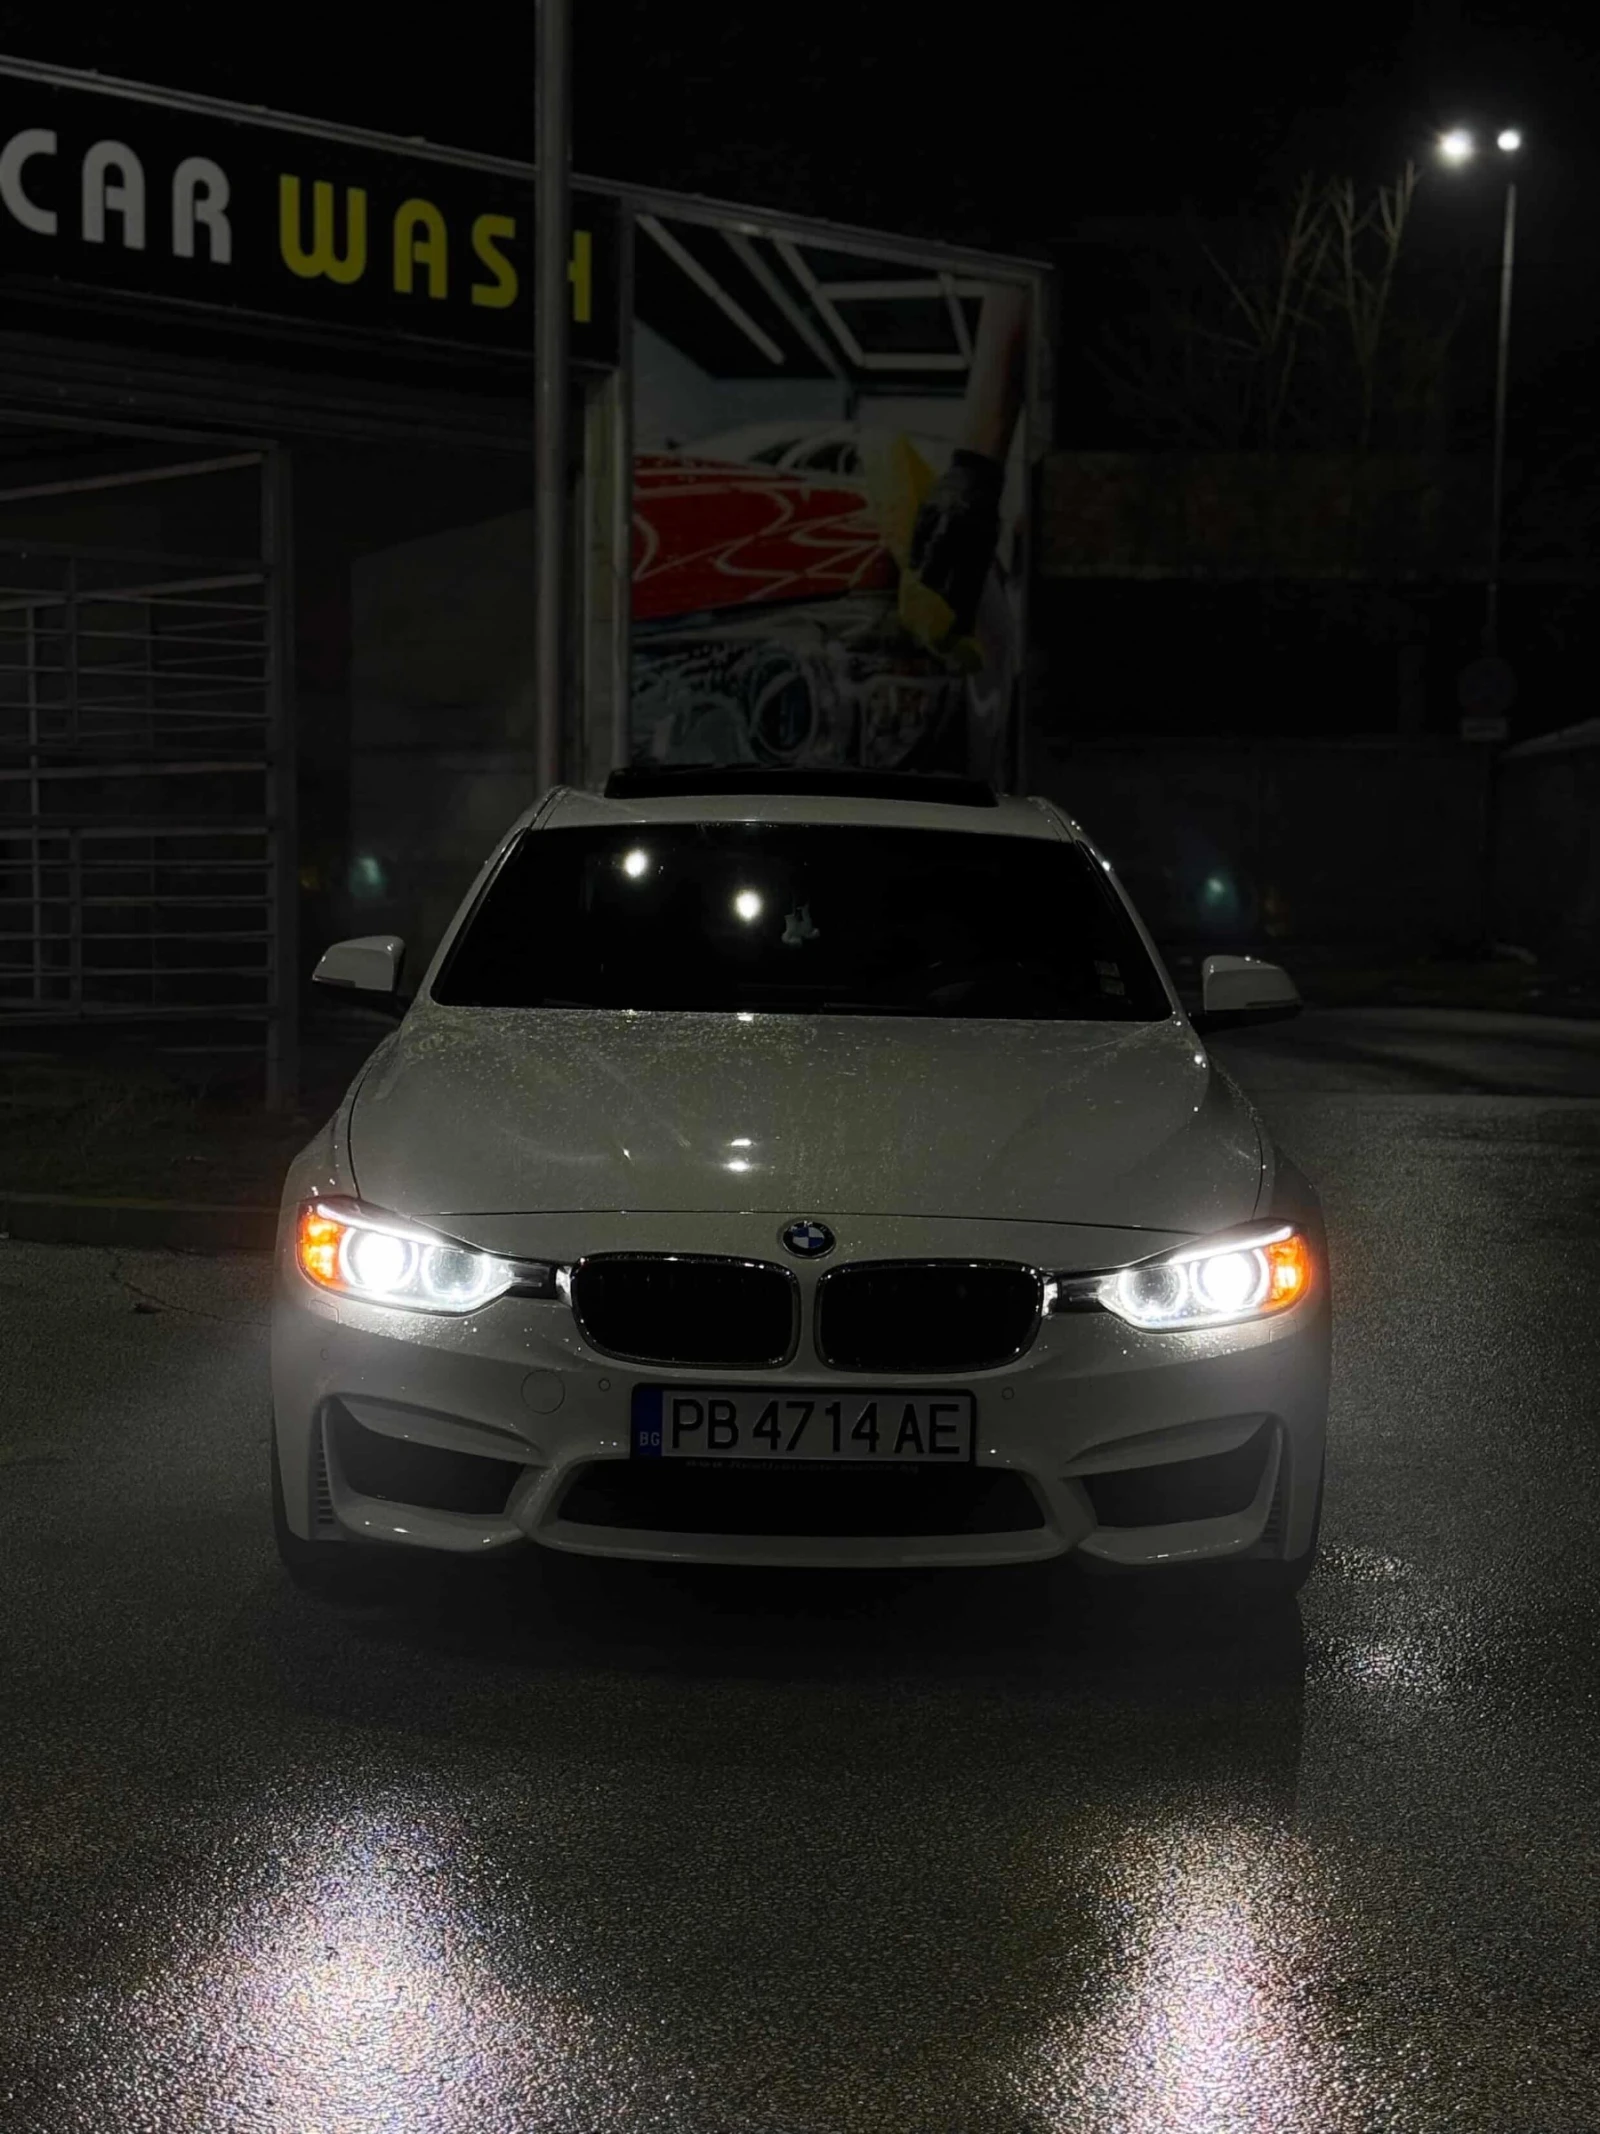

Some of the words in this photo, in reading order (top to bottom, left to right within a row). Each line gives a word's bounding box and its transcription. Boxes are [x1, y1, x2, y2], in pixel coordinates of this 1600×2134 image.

[0, 128, 232, 265] CAR
[639, 1431, 660, 1446] BG
[672, 1399, 738, 1450] PB
[753, 1401, 878, 1452] 4714
[894, 1404, 960, 1453] AE
